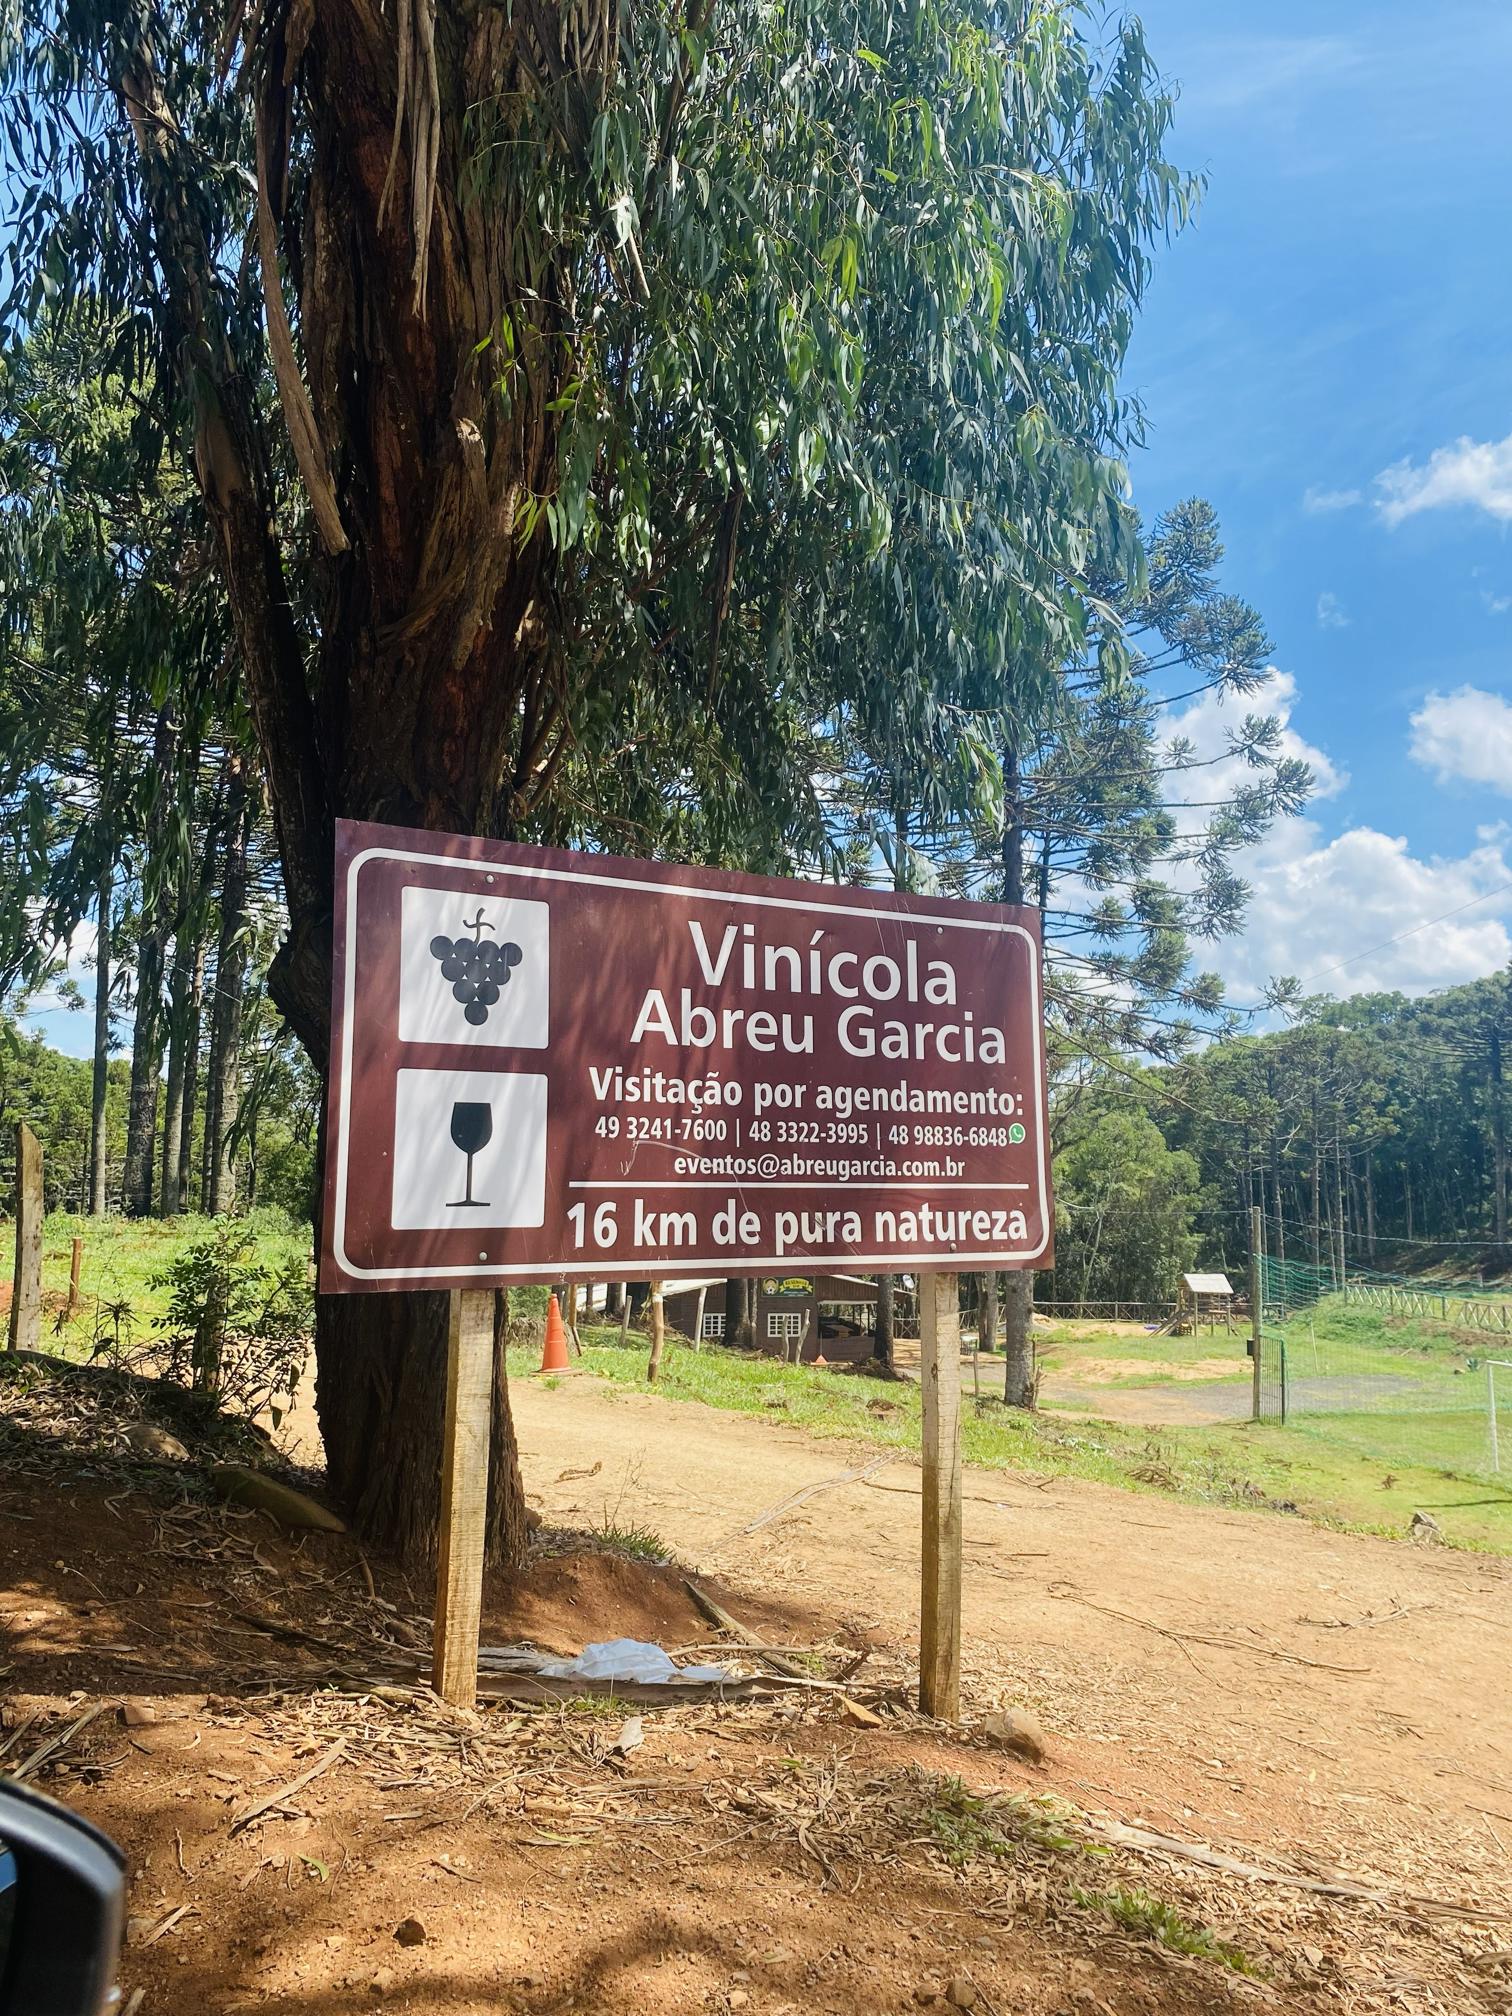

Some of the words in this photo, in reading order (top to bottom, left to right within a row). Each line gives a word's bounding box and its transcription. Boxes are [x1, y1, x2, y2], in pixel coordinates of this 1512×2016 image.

[687, 920, 957, 1006] Vinícola
[629, 987, 814, 1054] Abreu
[837, 1004, 1006, 1065] Garcia
[588, 1065, 743, 1115] Visitação
[754, 1082, 807, 1116] por
[815, 1079, 1024, 1119] agendamento:
[594, 1116, 620, 1139] 49
[626, 1116, 727, 1141] 3241-7600
[748, 1120, 771, 1142] 48
[777, 1121, 869, 1144] 3322-3995
[888, 1124, 909, 1145] 48
[913, 1125, 1008, 1148] 98836-6848
[674, 1152, 966, 1182] eventos@abreugarcia.com.br
[566, 1201, 618, 1250] 16
[633, 1198, 697, 1247] km
[712, 1198, 761, 1245] de
[775, 1211, 862, 1256] pura
[875, 1202, 1029, 1243] natureza
